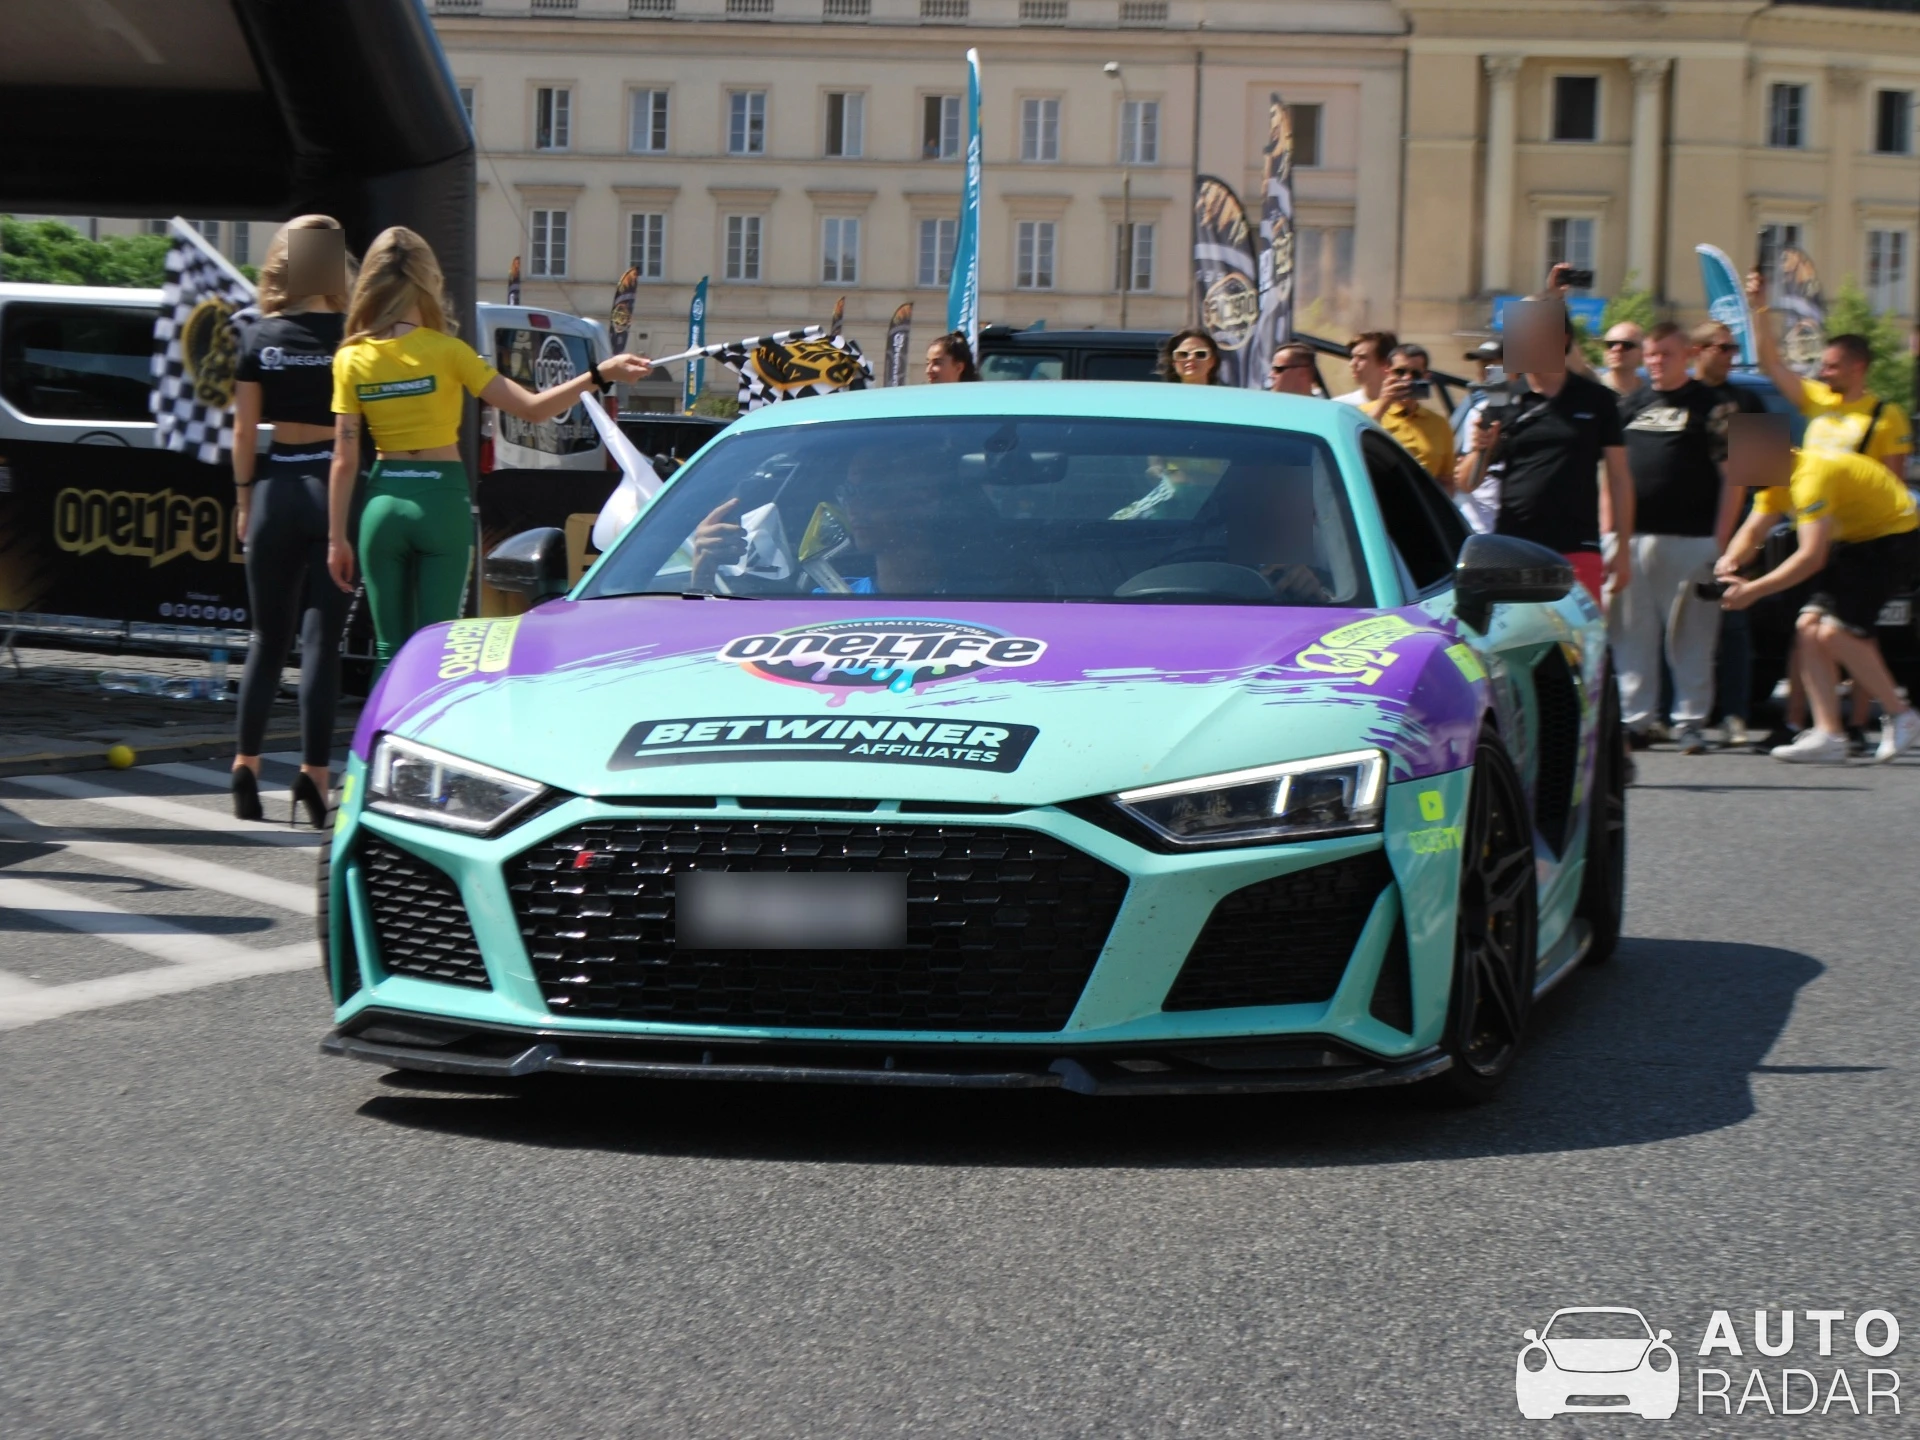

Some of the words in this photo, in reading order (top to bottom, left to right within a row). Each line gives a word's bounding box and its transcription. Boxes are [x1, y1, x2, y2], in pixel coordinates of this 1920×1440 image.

[804, 621, 986, 636] ONELIFERALLYNFT.COM
[641, 720, 1010, 747] BETWINNER
[848, 742, 999, 763] AFFILIATES
